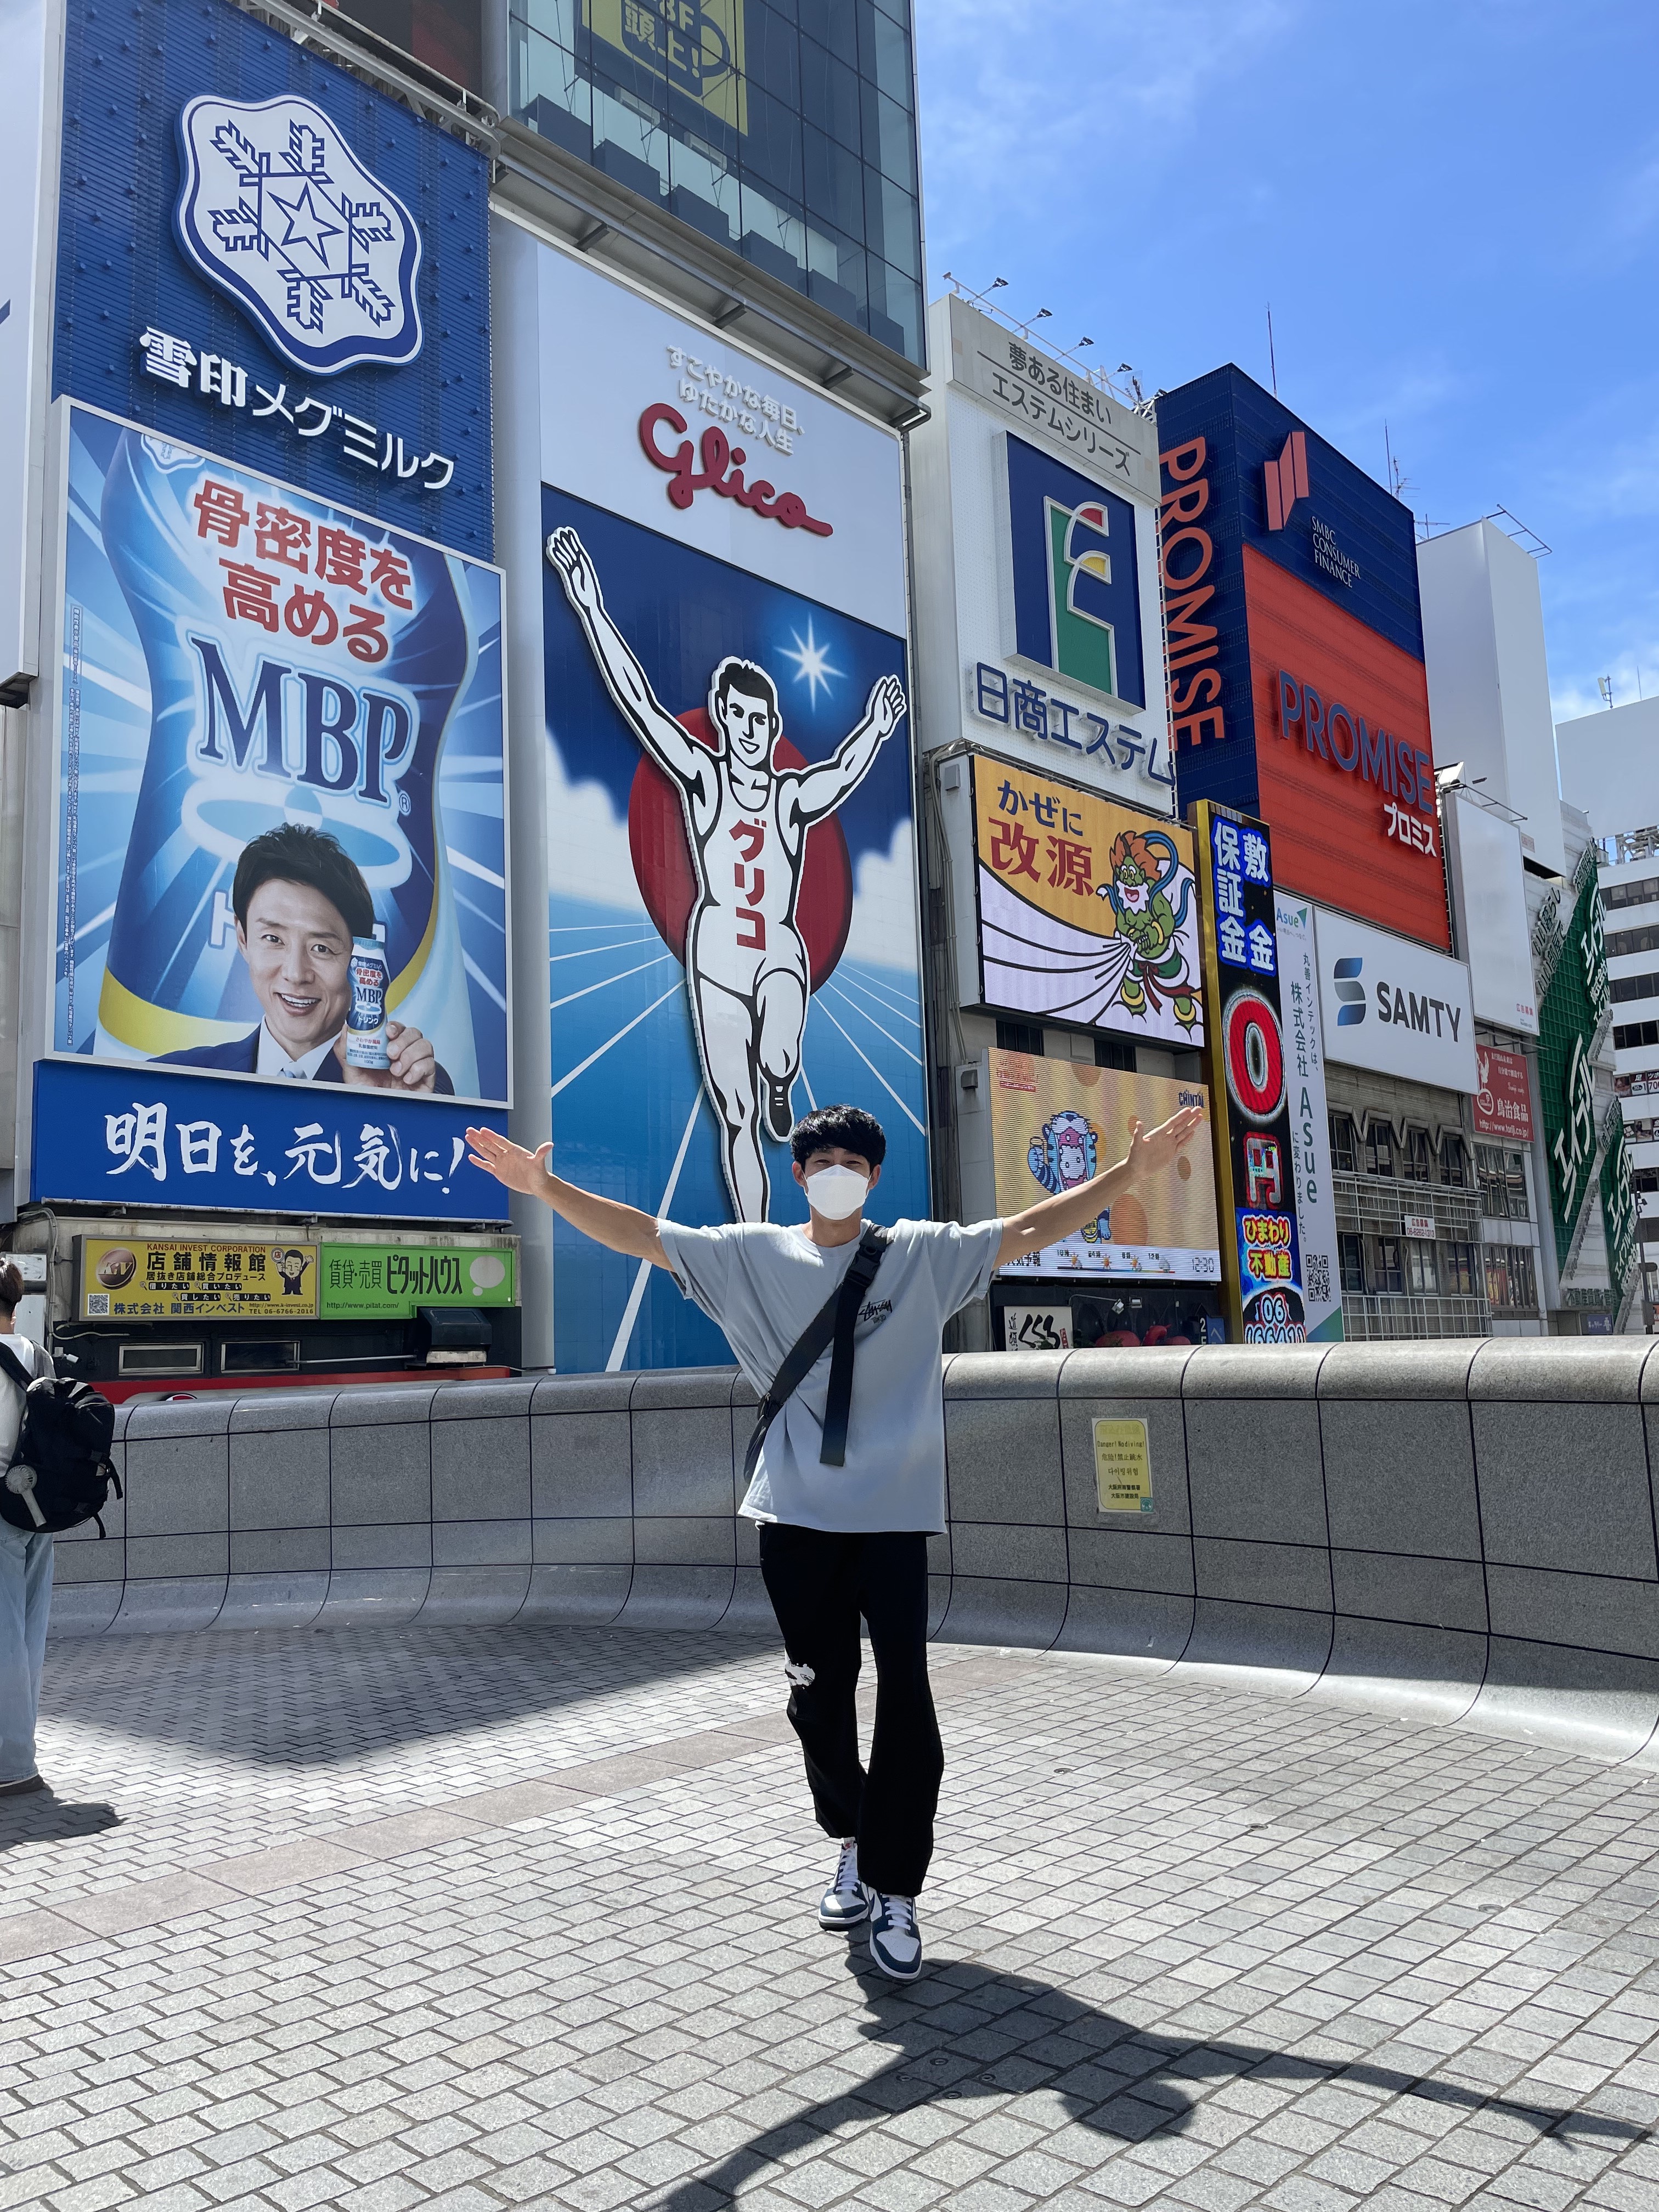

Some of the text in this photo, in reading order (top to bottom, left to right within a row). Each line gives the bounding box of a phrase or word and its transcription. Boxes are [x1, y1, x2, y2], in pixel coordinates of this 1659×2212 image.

[139, 326, 455, 489] 雪印メグミルク
[667, 345, 805, 436] すこやかな毎日、
[1009, 341, 1111, 425] 夢ある住まい
[679, 378, 794, 456] ゆたかな人生
[992, 372, 1131, 476] エステムシリーズ
[194, 479, 415, 611] 骨密度を
[1312, 516, 1336, 545] SMBC
[1313, 533, 1361, 580] CONSUMER
[1156, 436, 1224, 751] PROMISE
[1314, 549, 1353, 588] FINANCE
[219, 558, 388, 663] 高める
[191, 636, 410, 804] MBP
[976, 662, 1176, 788] 日商エステム
[1277, 669, 1433, 815] PROMISE
[997, 779, 1084, 837] かぜに
[1383, 802, 1437, 857] プロミス
[729, 817, 768, 951] グリコ
[988, 816, 1094, 896] 改源
[1214, 821, 1247, 963] 保証金
[1276, 907, 1299, 928] Asue
[356, 968, 382, 979] 骨密度を
[357, 987, 382, 1003] MBP
[359, 977, 379, 987] 高める
[358, 1015, 379, 1025] ドリンク
[1303, 952, 1318, 1071] 丸善インテックは、
[1376, 981, 1461, 1042] SAMTY
[1290, 981, 1318, 1204] 株式会社 Asue
[1292, 1131, 1307, 1243] に変わりました。
[146, 1251, 266, 1272] 店舗情報館
[180, 1244, 208, 1252] INVEST
[211, 1245, 266, 1253] CORPORATION
[1244, 1216, 1291, 1248] ひまわり
[146, 1271, 266, 1281] 居抜き店舗総合プロデュース
[329, 1254, 463, 1295] 賃貸・売買 ピタットハウス
[1248, 1250, 1293, 1280] 不動産
[114, 1302, 245, 1314] 株式会社 関西インベスト
[1262, 1294, 1286, 1324] 06
